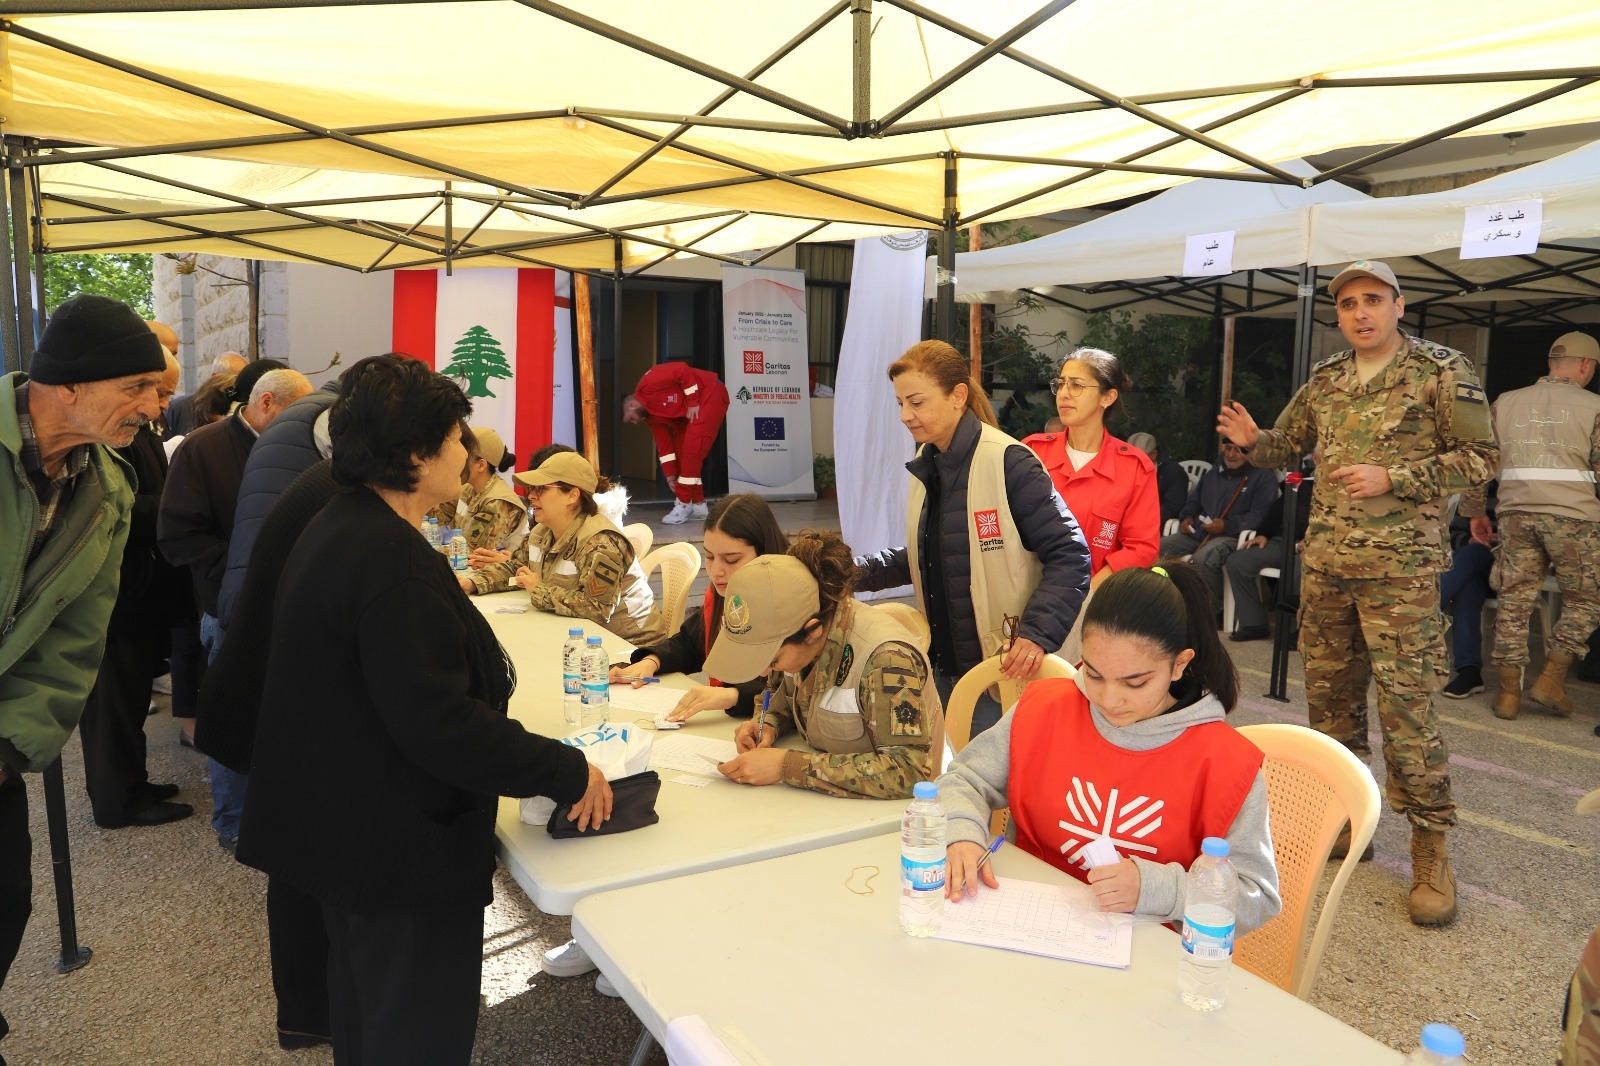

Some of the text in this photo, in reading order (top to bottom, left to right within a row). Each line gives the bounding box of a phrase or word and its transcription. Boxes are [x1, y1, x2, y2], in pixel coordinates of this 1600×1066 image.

[1488, 209, 1525, 222] طب غدد
[1483, 229, 1511, 242] سكري
[1206, 240, 1219, 252] طب
[1202, 258, 1214, 270] عام
[769, 327, 788, 335] Legacy
[763, 335, 798, 343] Communities
[1511, 452, 1567, 468] CIMIC
[978, 538, 1004, 546] Caritas
